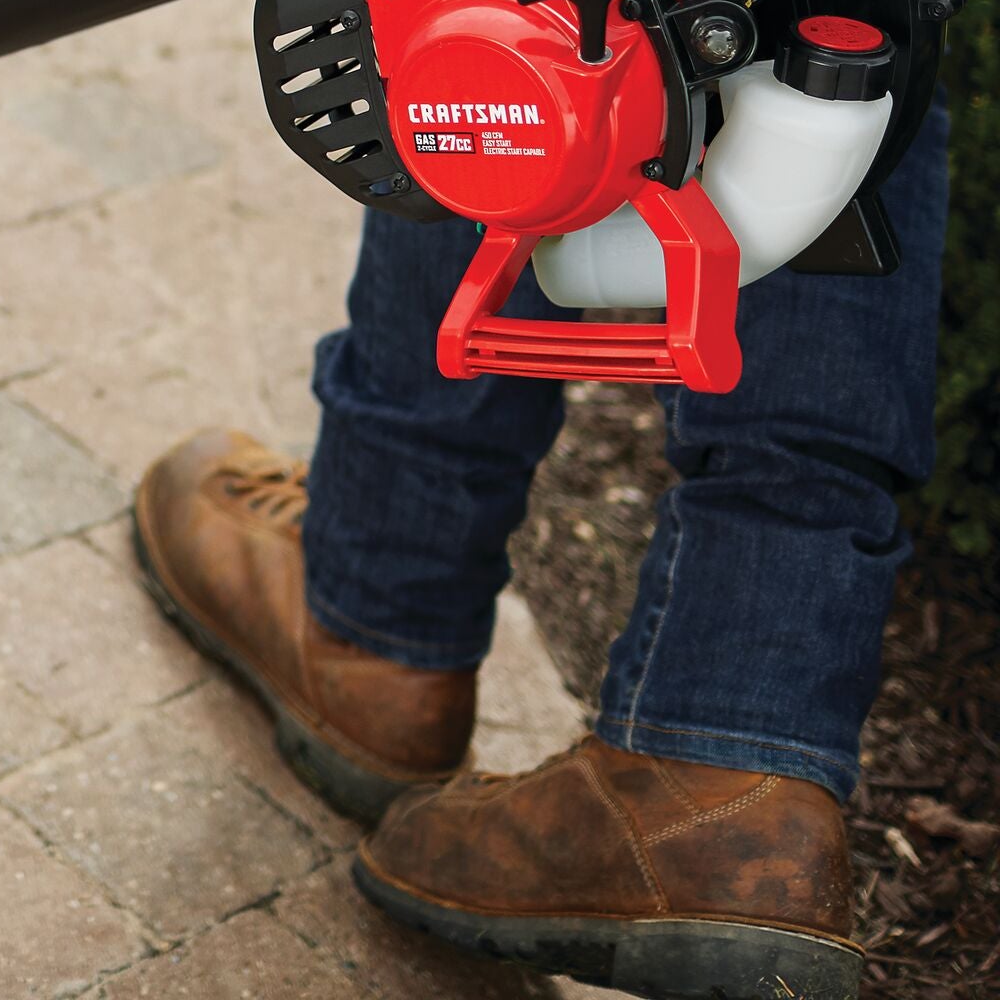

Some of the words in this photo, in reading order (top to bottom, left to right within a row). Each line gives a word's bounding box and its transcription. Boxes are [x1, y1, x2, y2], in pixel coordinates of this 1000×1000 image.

[408, 104, 540, 125] CRAFTSMAN
[415, 134, 436, 145] GAS
[523, 148, 546, 156] CAPABLE
